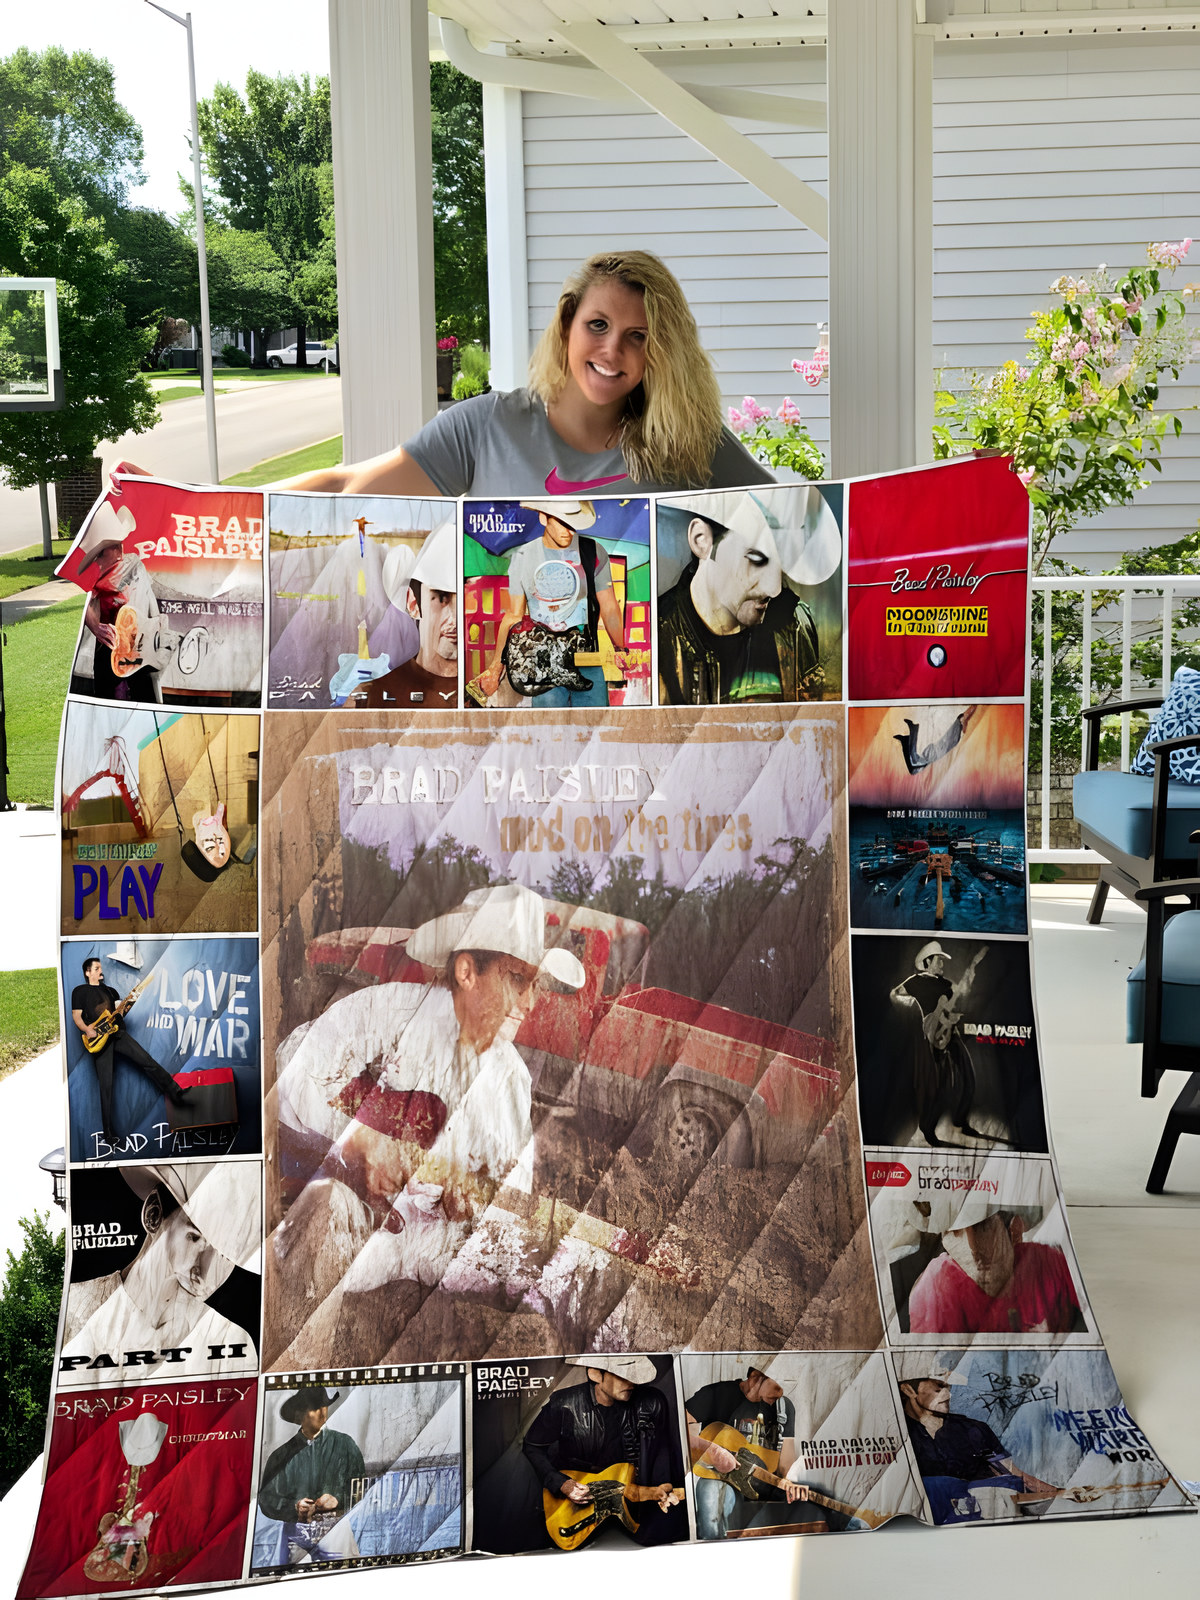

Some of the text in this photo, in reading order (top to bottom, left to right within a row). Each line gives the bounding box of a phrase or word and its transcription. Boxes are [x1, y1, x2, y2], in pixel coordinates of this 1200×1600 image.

[350, 765, 464, 805] BRAD
[73, 863, 164, 921] PLAY
[159, 967, 251, 1015] LOVE
[174, 1014, 250, 1059] WAR
[86, 1131, 149, 1161] BRAD
[72, 1222, 122, 1238] BRAD
[60, 1343, 248, 1371] PART II
[477, 1366, 529, 1380] BRAD
[477, 1376, 555, 1393] PAISLEY
